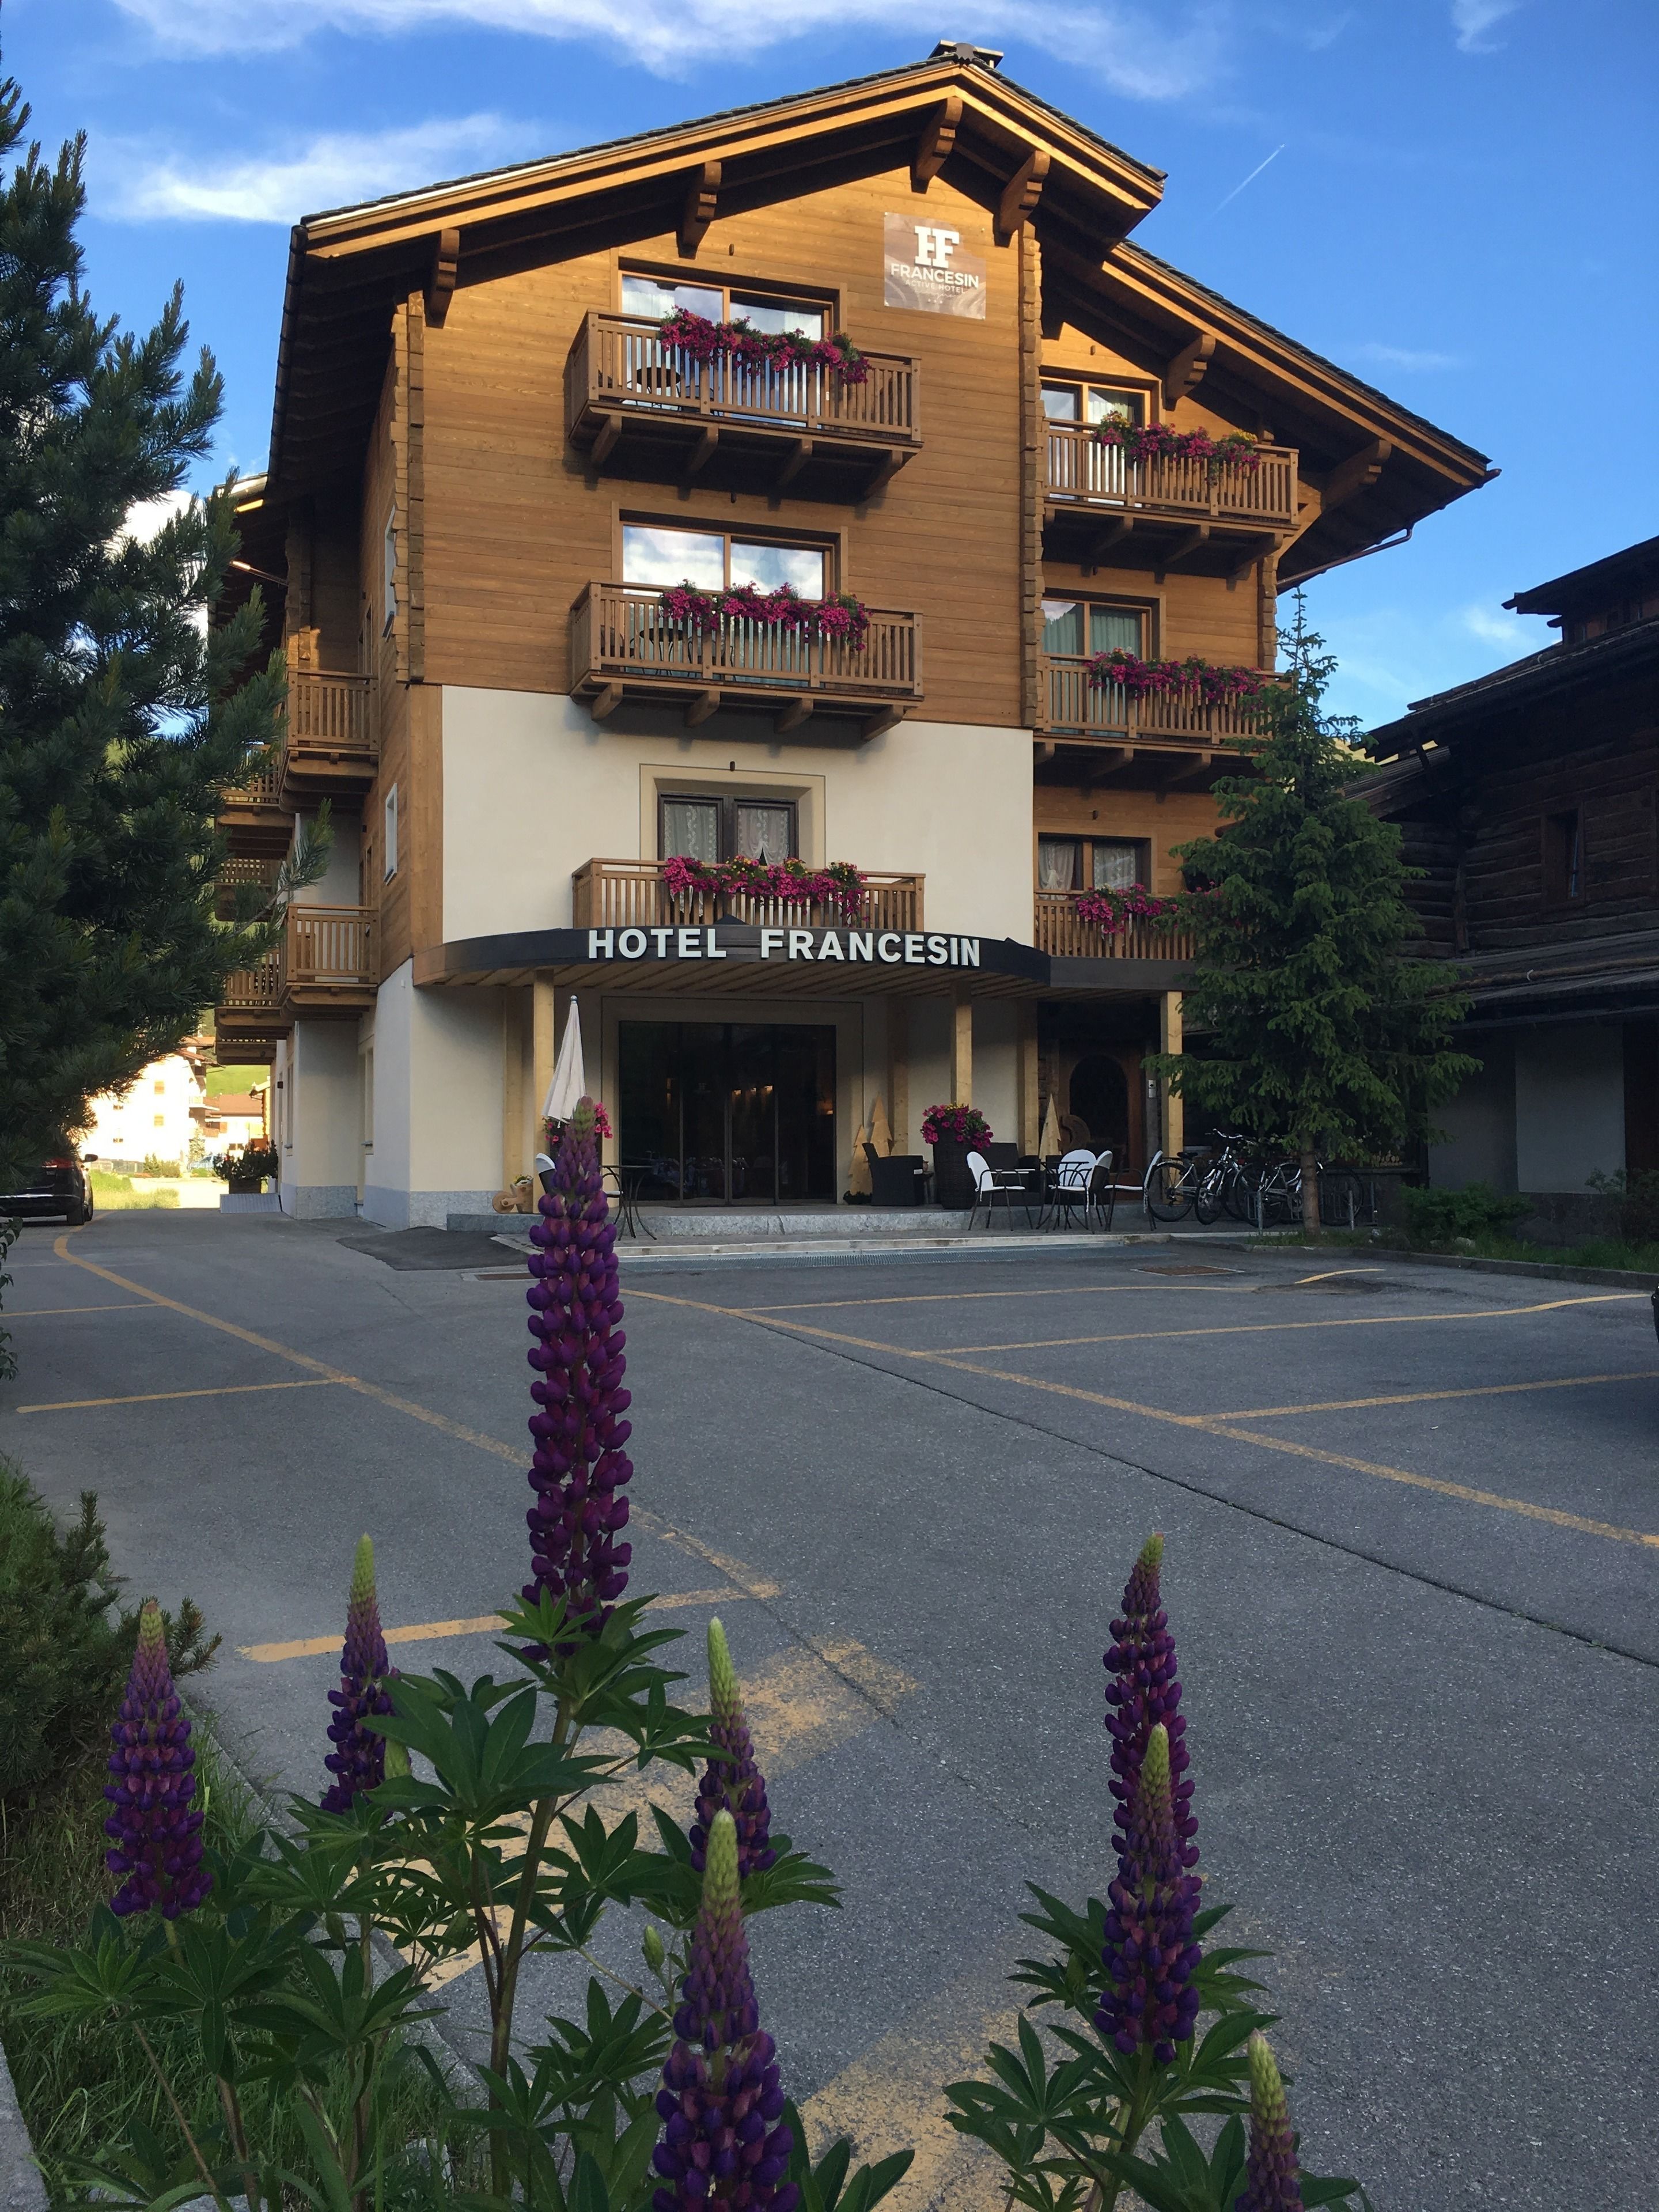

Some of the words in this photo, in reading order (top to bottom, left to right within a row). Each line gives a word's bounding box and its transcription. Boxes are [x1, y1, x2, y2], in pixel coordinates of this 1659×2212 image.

[891, 263, 979, 289] FRANCESIN
[905, 279, 935, 289] ACTIVE
[938, 283, 965, 293] HOTEL
[588, 928, 727, 959] HOTEL
[761, 929, 980, 967] FRANCESIN
